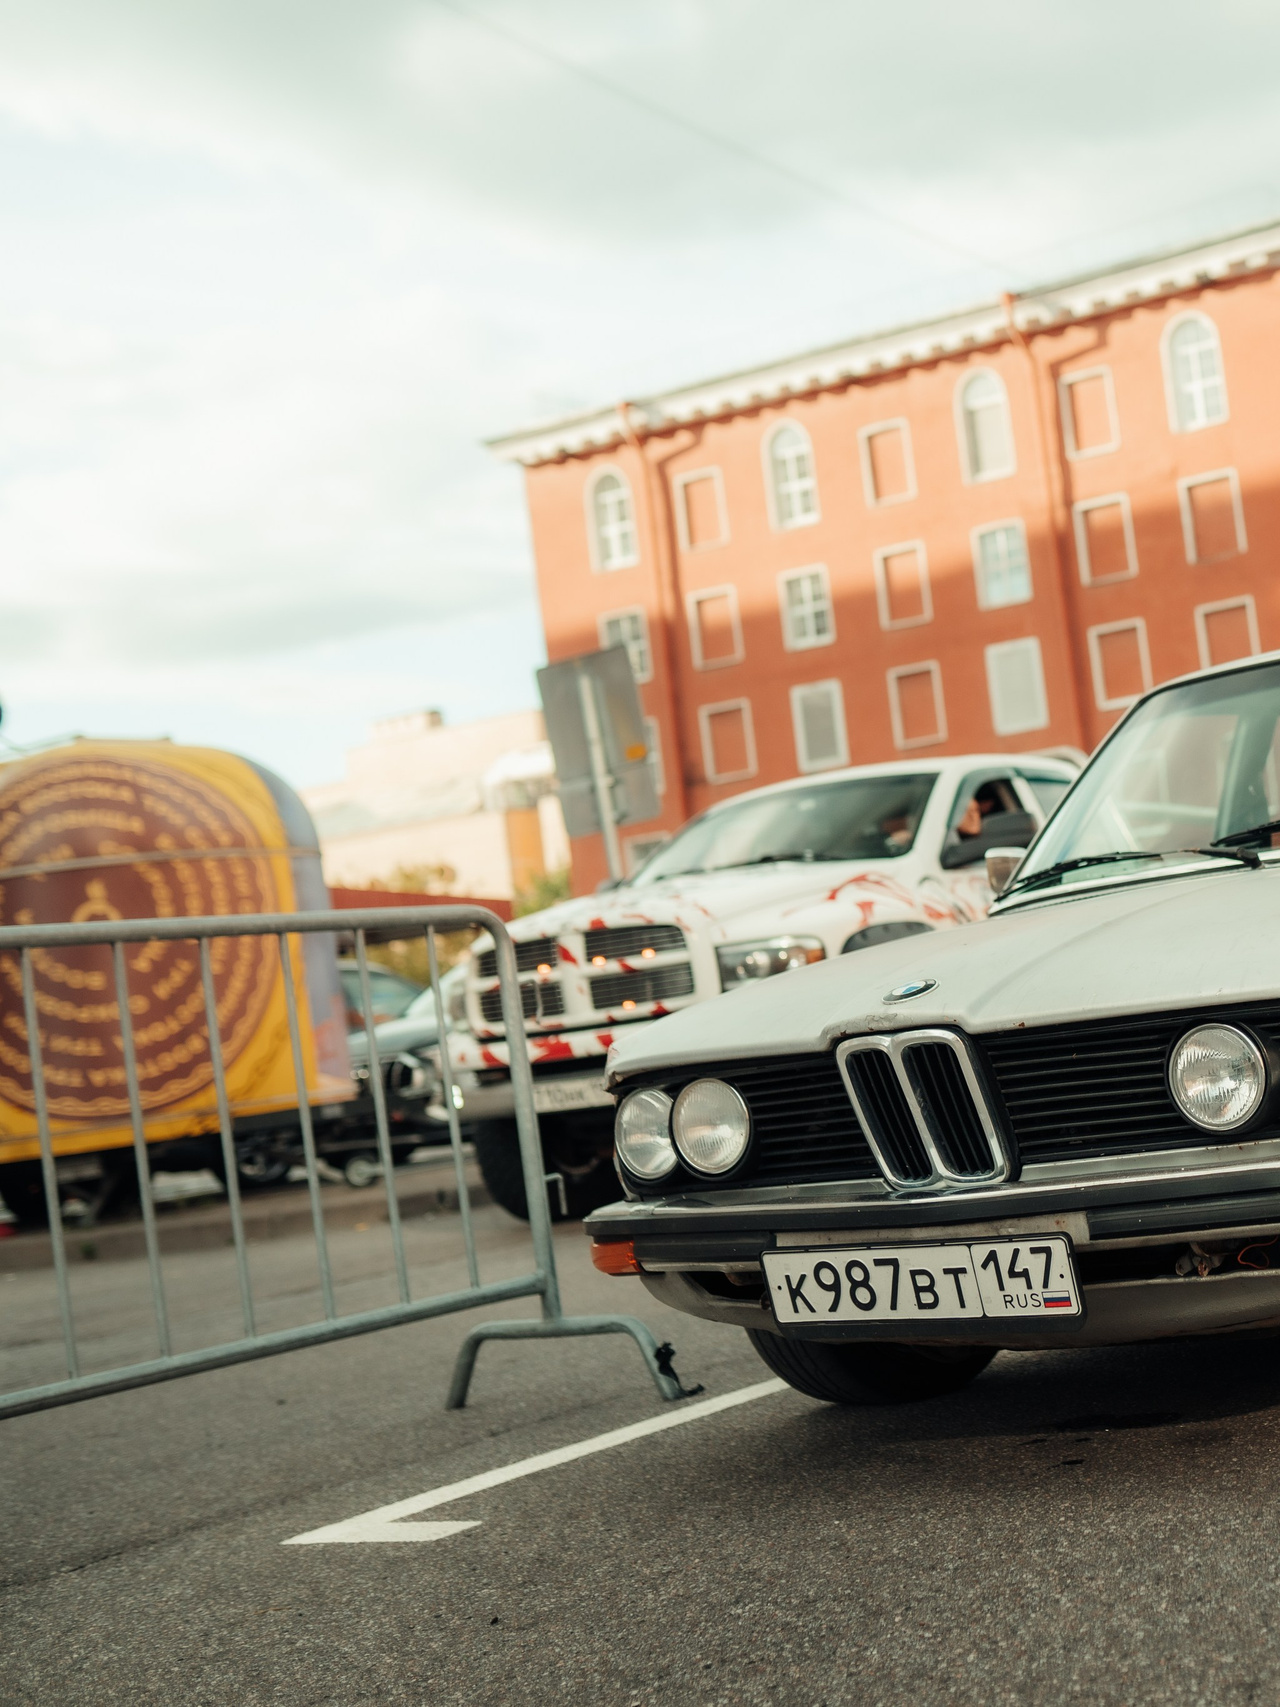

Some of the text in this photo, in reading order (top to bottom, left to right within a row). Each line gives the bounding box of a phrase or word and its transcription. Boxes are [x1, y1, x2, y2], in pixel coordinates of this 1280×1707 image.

[784, 1245, 1053, 1313] К987ВТ 147
[1003, 1293, 1042, 1309] RUS
